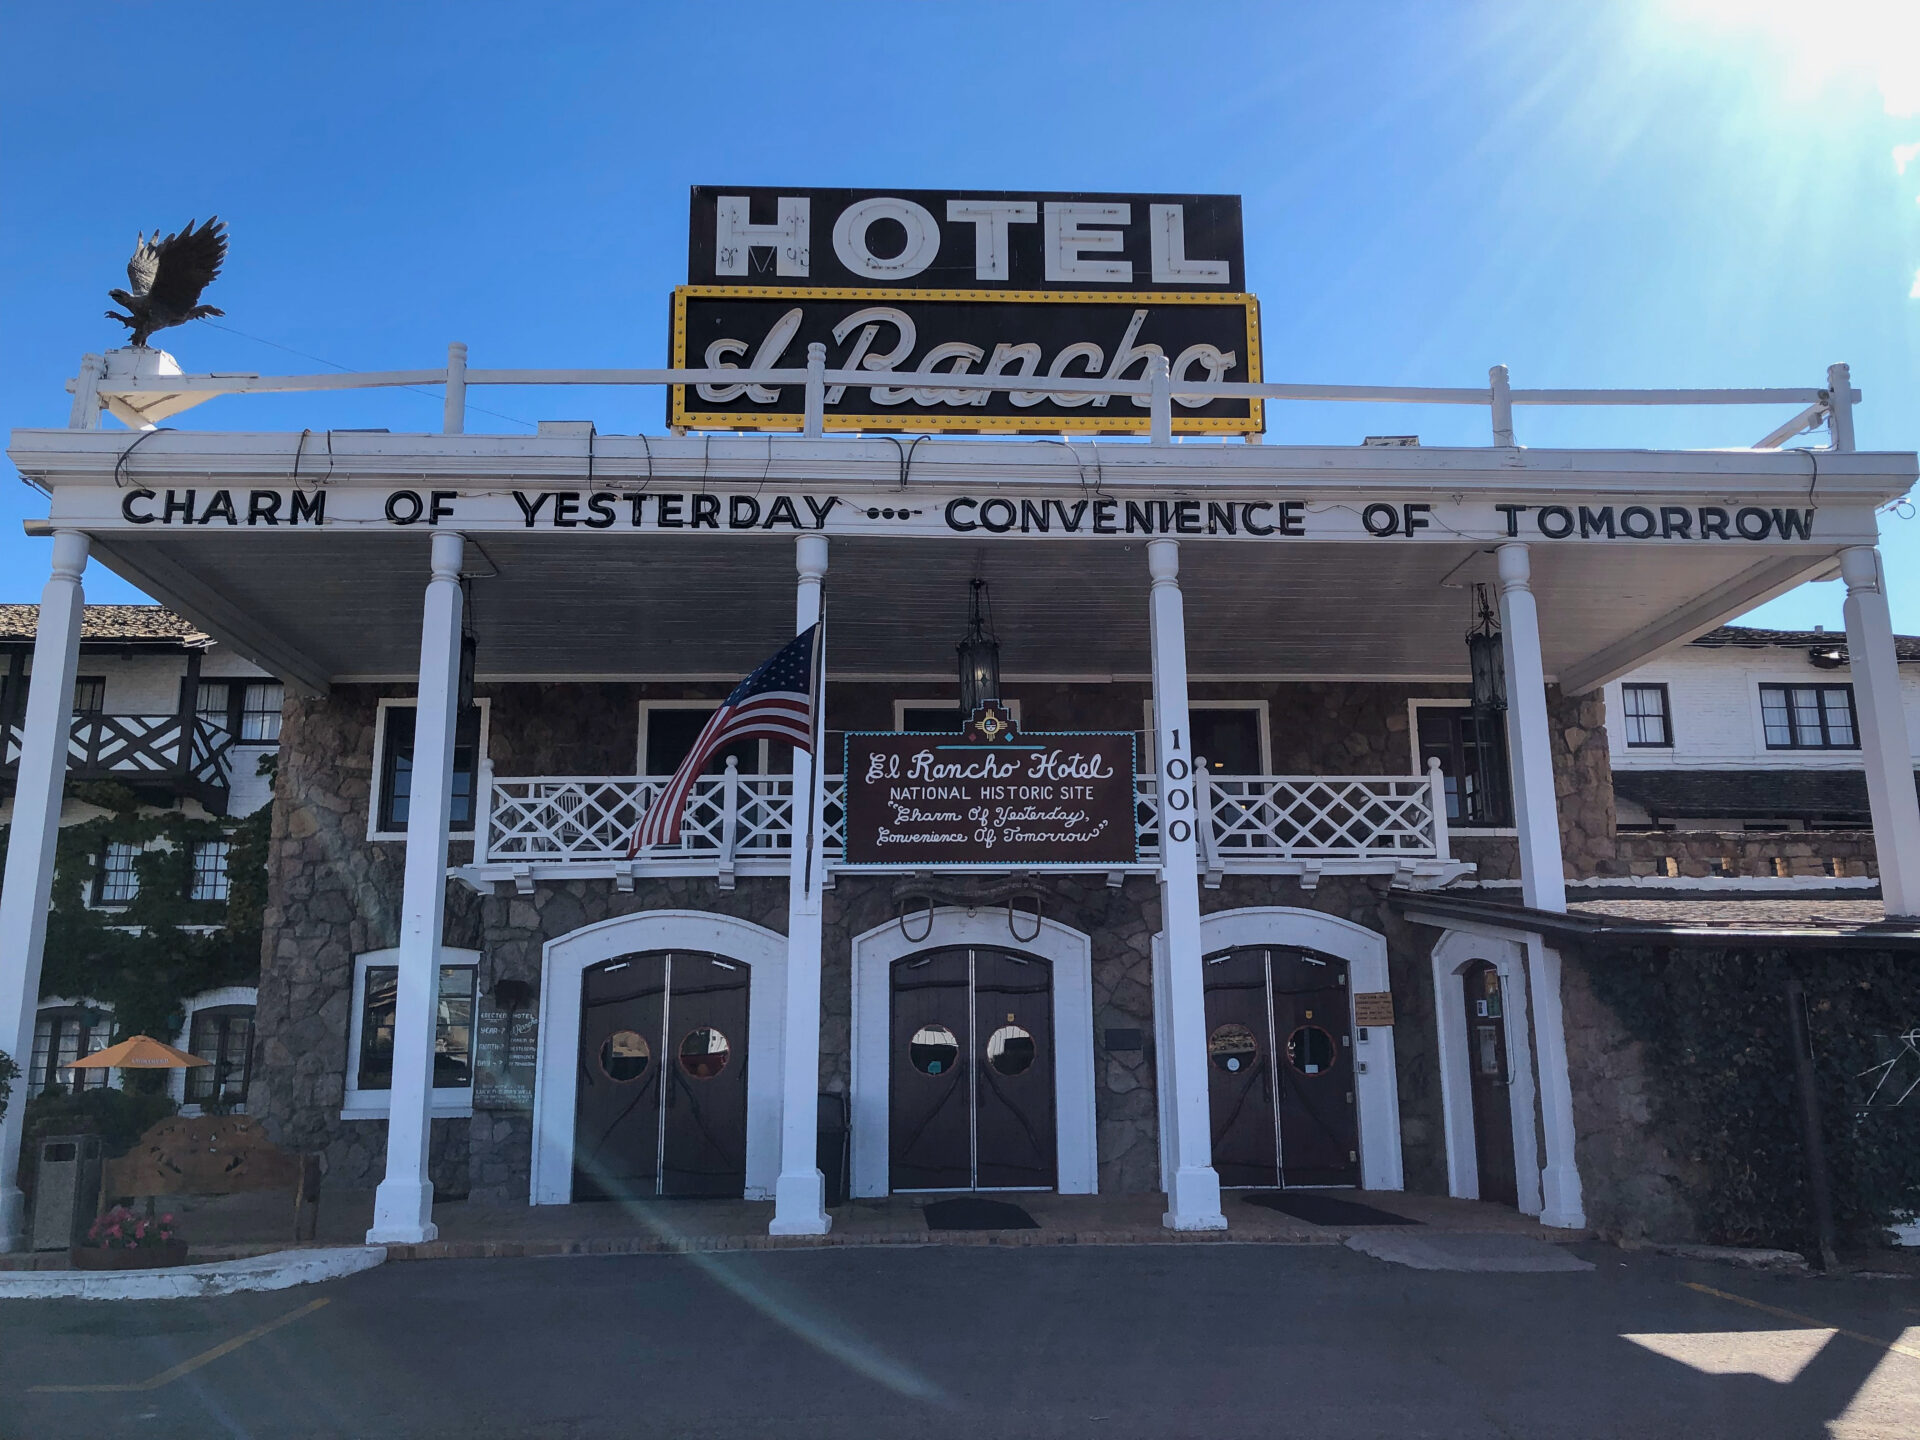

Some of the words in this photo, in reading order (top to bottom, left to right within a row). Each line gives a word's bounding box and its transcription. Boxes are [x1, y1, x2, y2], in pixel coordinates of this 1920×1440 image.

[715, 196, 1230, 283] HOTEL
[824, 306, 1236, 408] Rancho
[121, 490, 327, 525] CHARM
[385, 490, 457, 525] OF
[513, 491, 838, 529] YESTERDAY
[944, 496, 1307, 535] CONVENIENCE
[1362, 502, 1429, 538] OF
[1495, 503, 1814, 542] TOMORROW
[865, 752, 900, 784] El
[907, 749, 1021, 782] Rancho
[1027, 749, 1114, 781] Hotel
[1166, 729, 1191, 842] 1000
[890, 786, 971, 800] NATIONAL
[981, 786, 1053, 800] HISTORIC
[1060, 786, 1094, 800] SITE
[876, 827, 968, 846] Convenience
[974, 828, 996, 848] Of
[968, 806, 989, 826] Of
[993, 806, 1090, 828] Yesterday,
